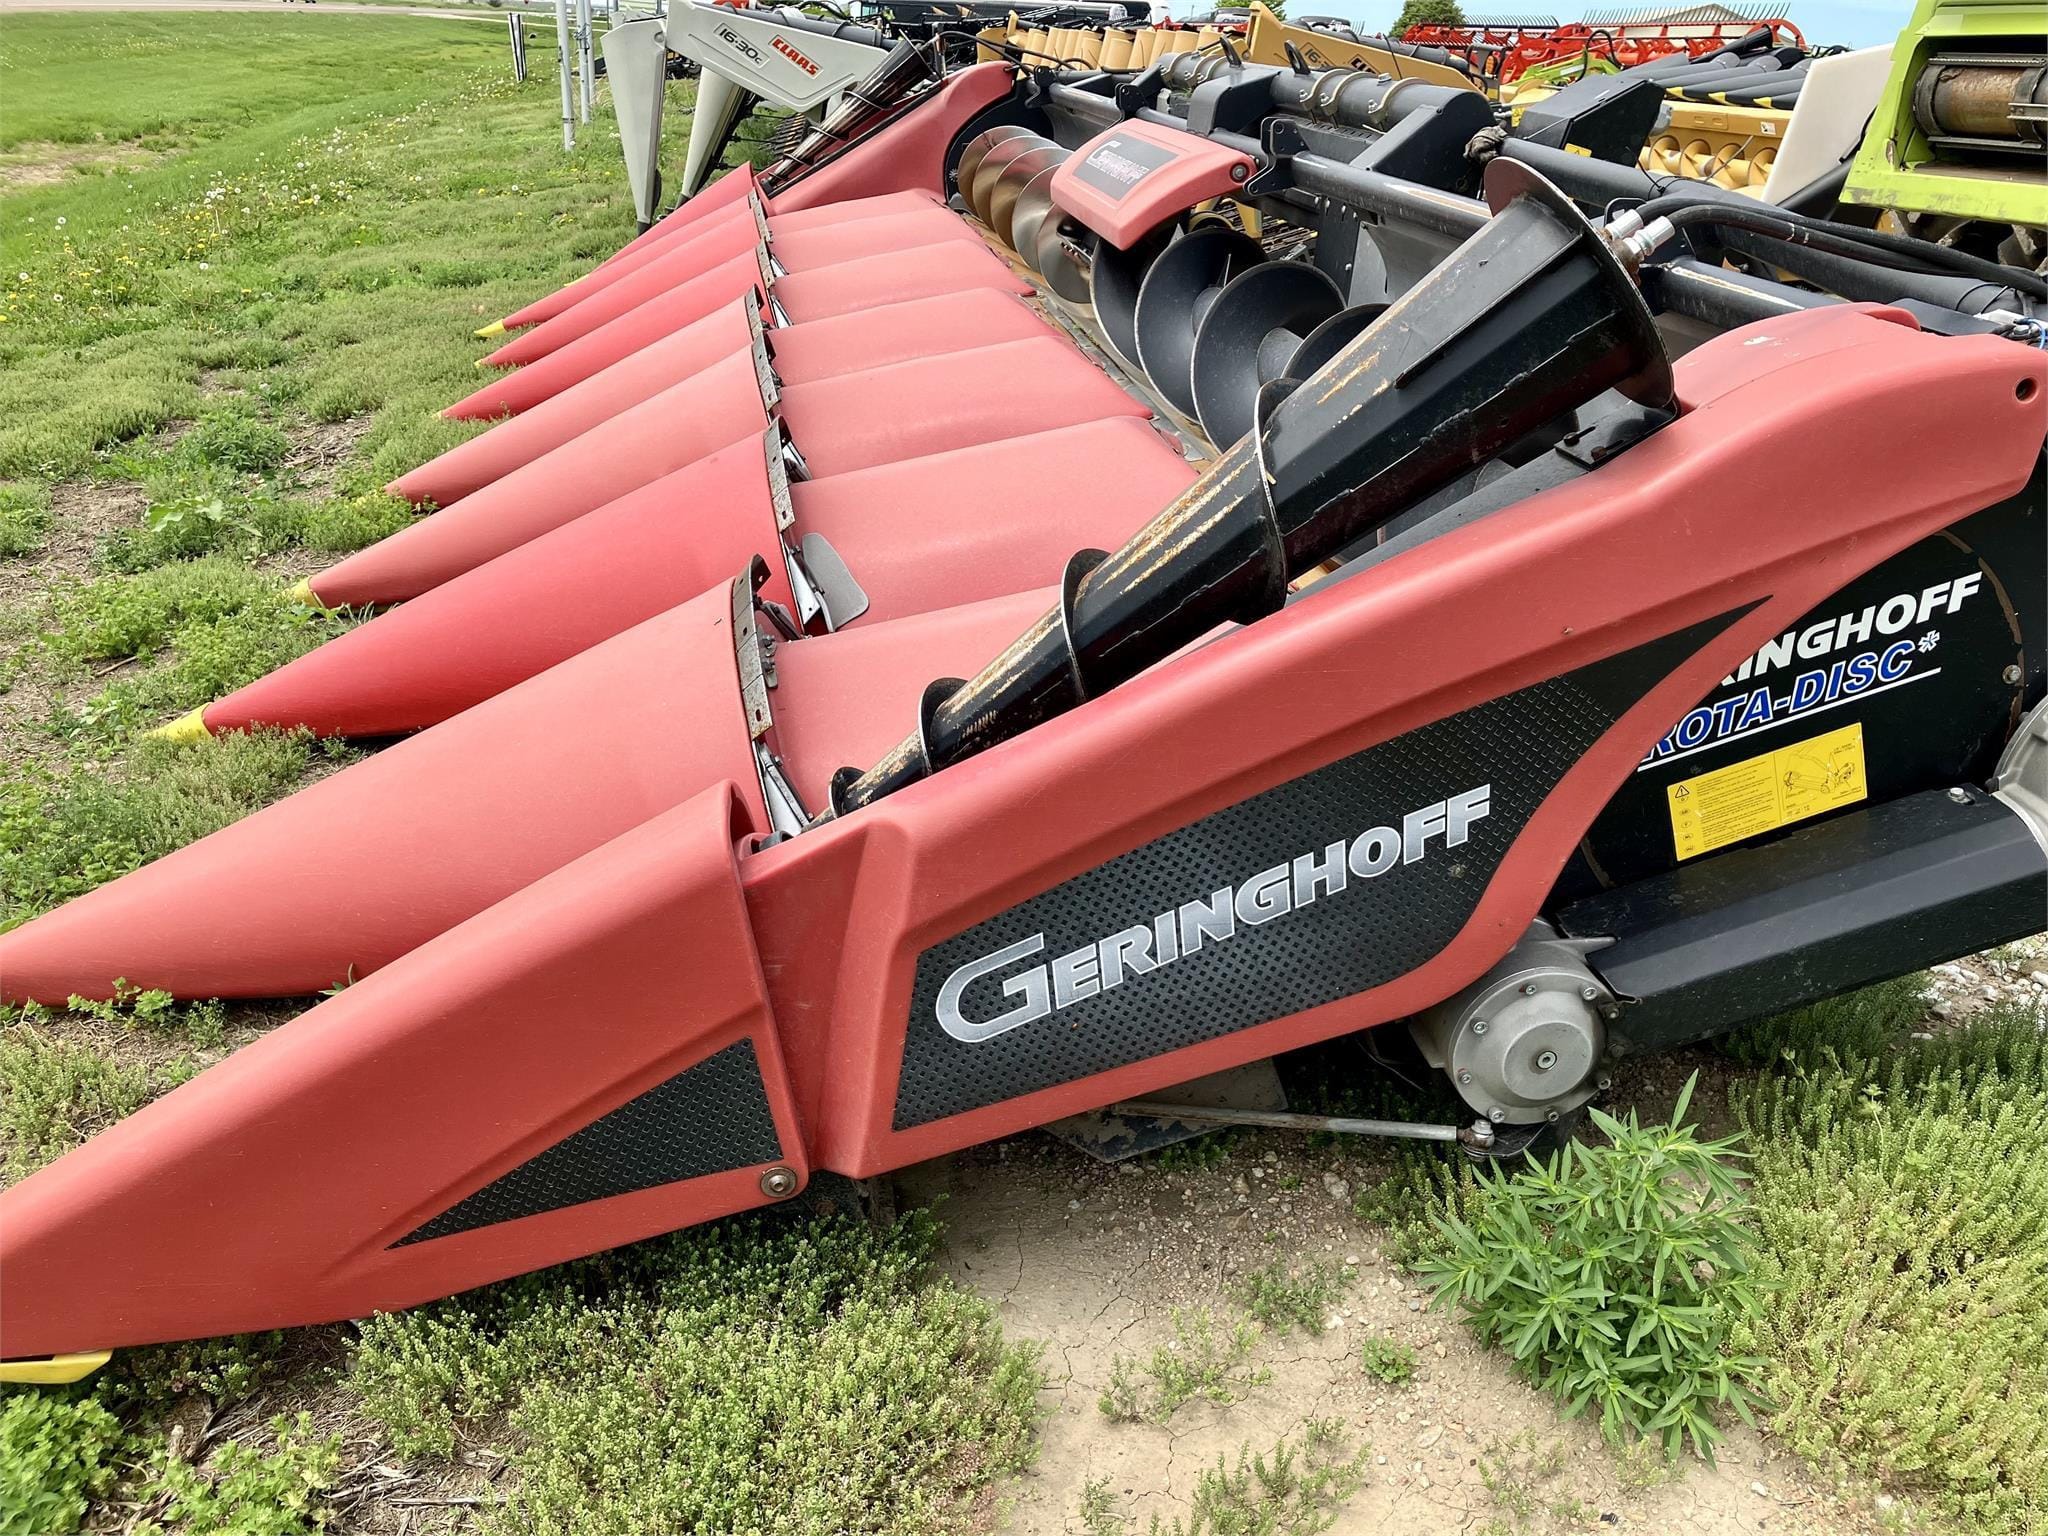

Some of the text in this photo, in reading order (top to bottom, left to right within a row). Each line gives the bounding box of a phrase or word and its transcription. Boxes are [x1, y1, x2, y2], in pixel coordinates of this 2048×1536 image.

[772, 38, 819, 76] CLAAS
[1719, 571, 1983, 687] INGHOFF
[935, 783, 1492, 1044] GERINGHOFF
